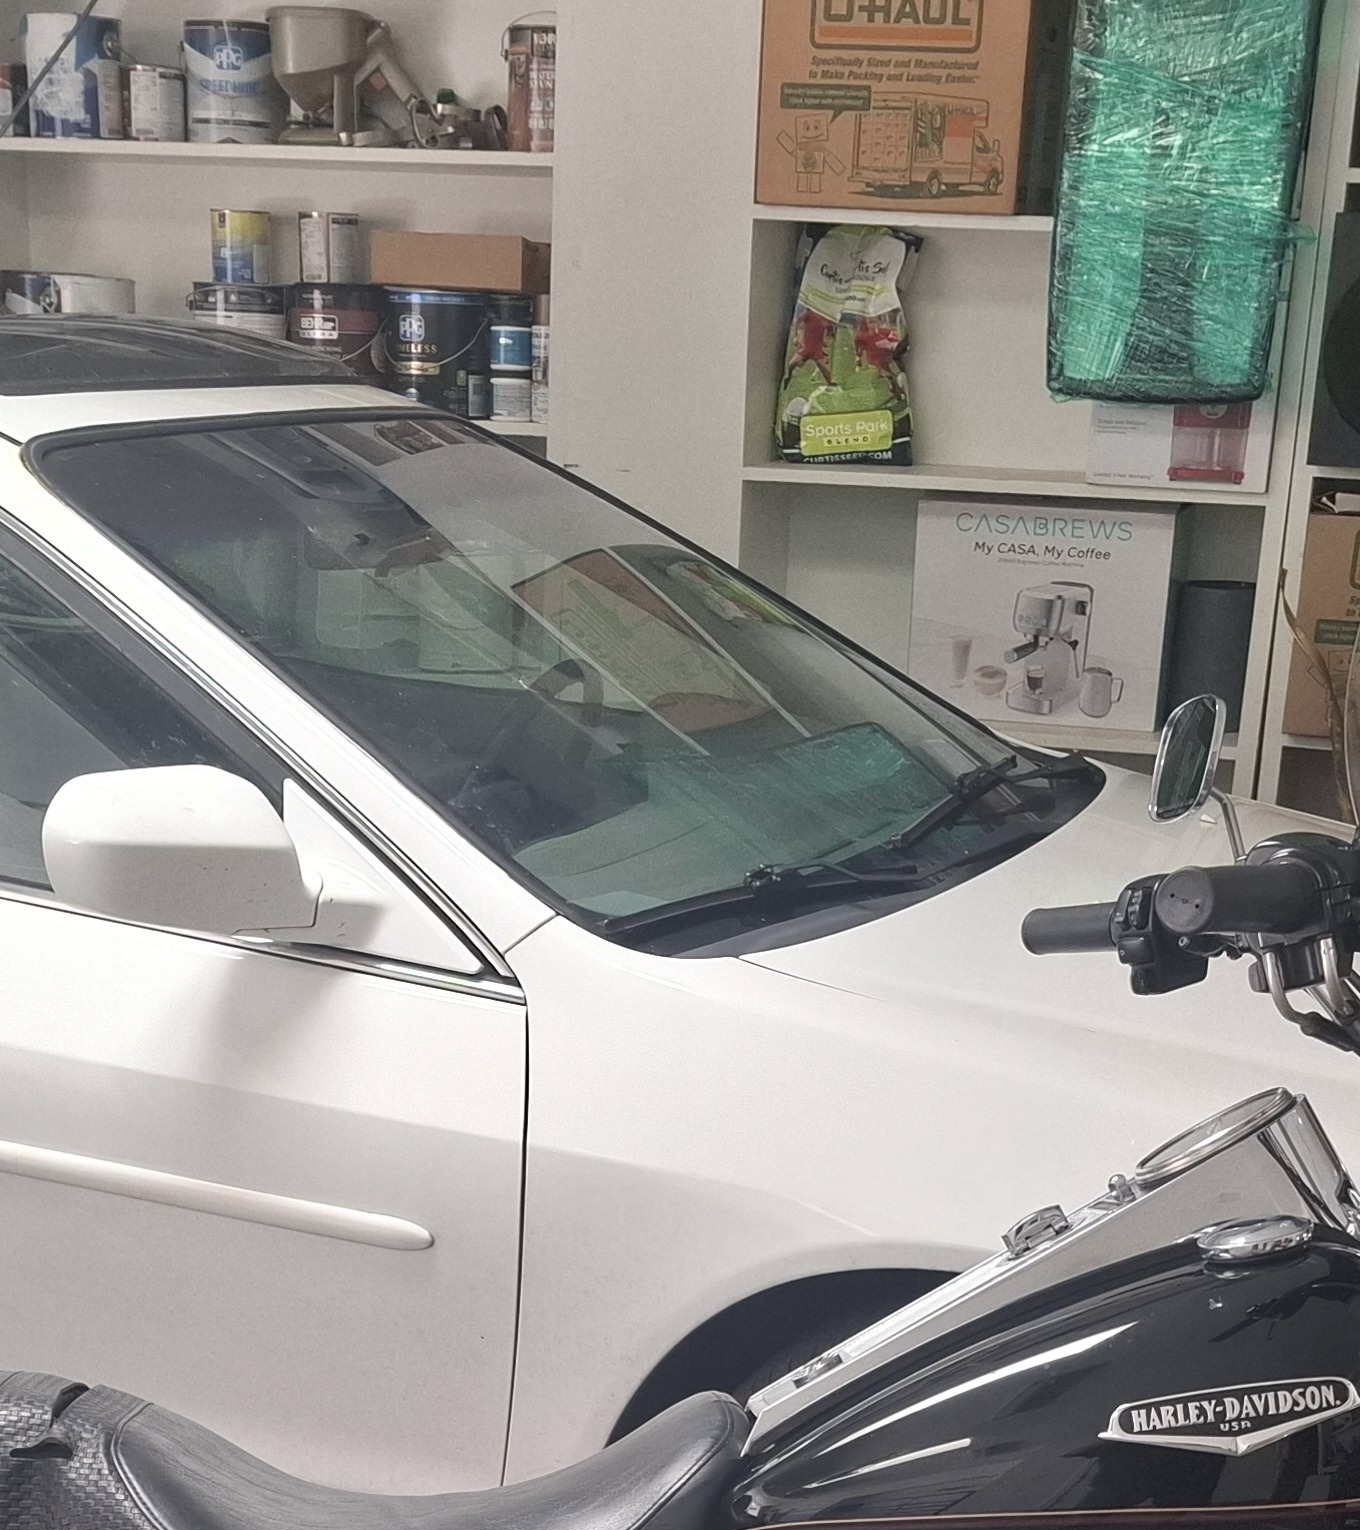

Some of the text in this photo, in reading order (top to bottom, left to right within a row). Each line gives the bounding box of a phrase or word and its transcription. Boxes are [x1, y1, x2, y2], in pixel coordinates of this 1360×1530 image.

[823, 0, 971, 26] U-HAUL
[215, 48, 242, 69] PPG
[400, 317, 423, 338] PPG
[805, 418, 889, 438] Sports Park
[826, 436, 869, 446] BLEND
[803, 451, 892, 463] CURTISSEECOM
[956, 512, 1133, 542] CASABREWS
[974, 541, 995, 556] My
[1044, 544, 1065, 560] My
[1067, 546, 1111, 561] Coffee
[1220, 1419, 1251, 1431] USA
